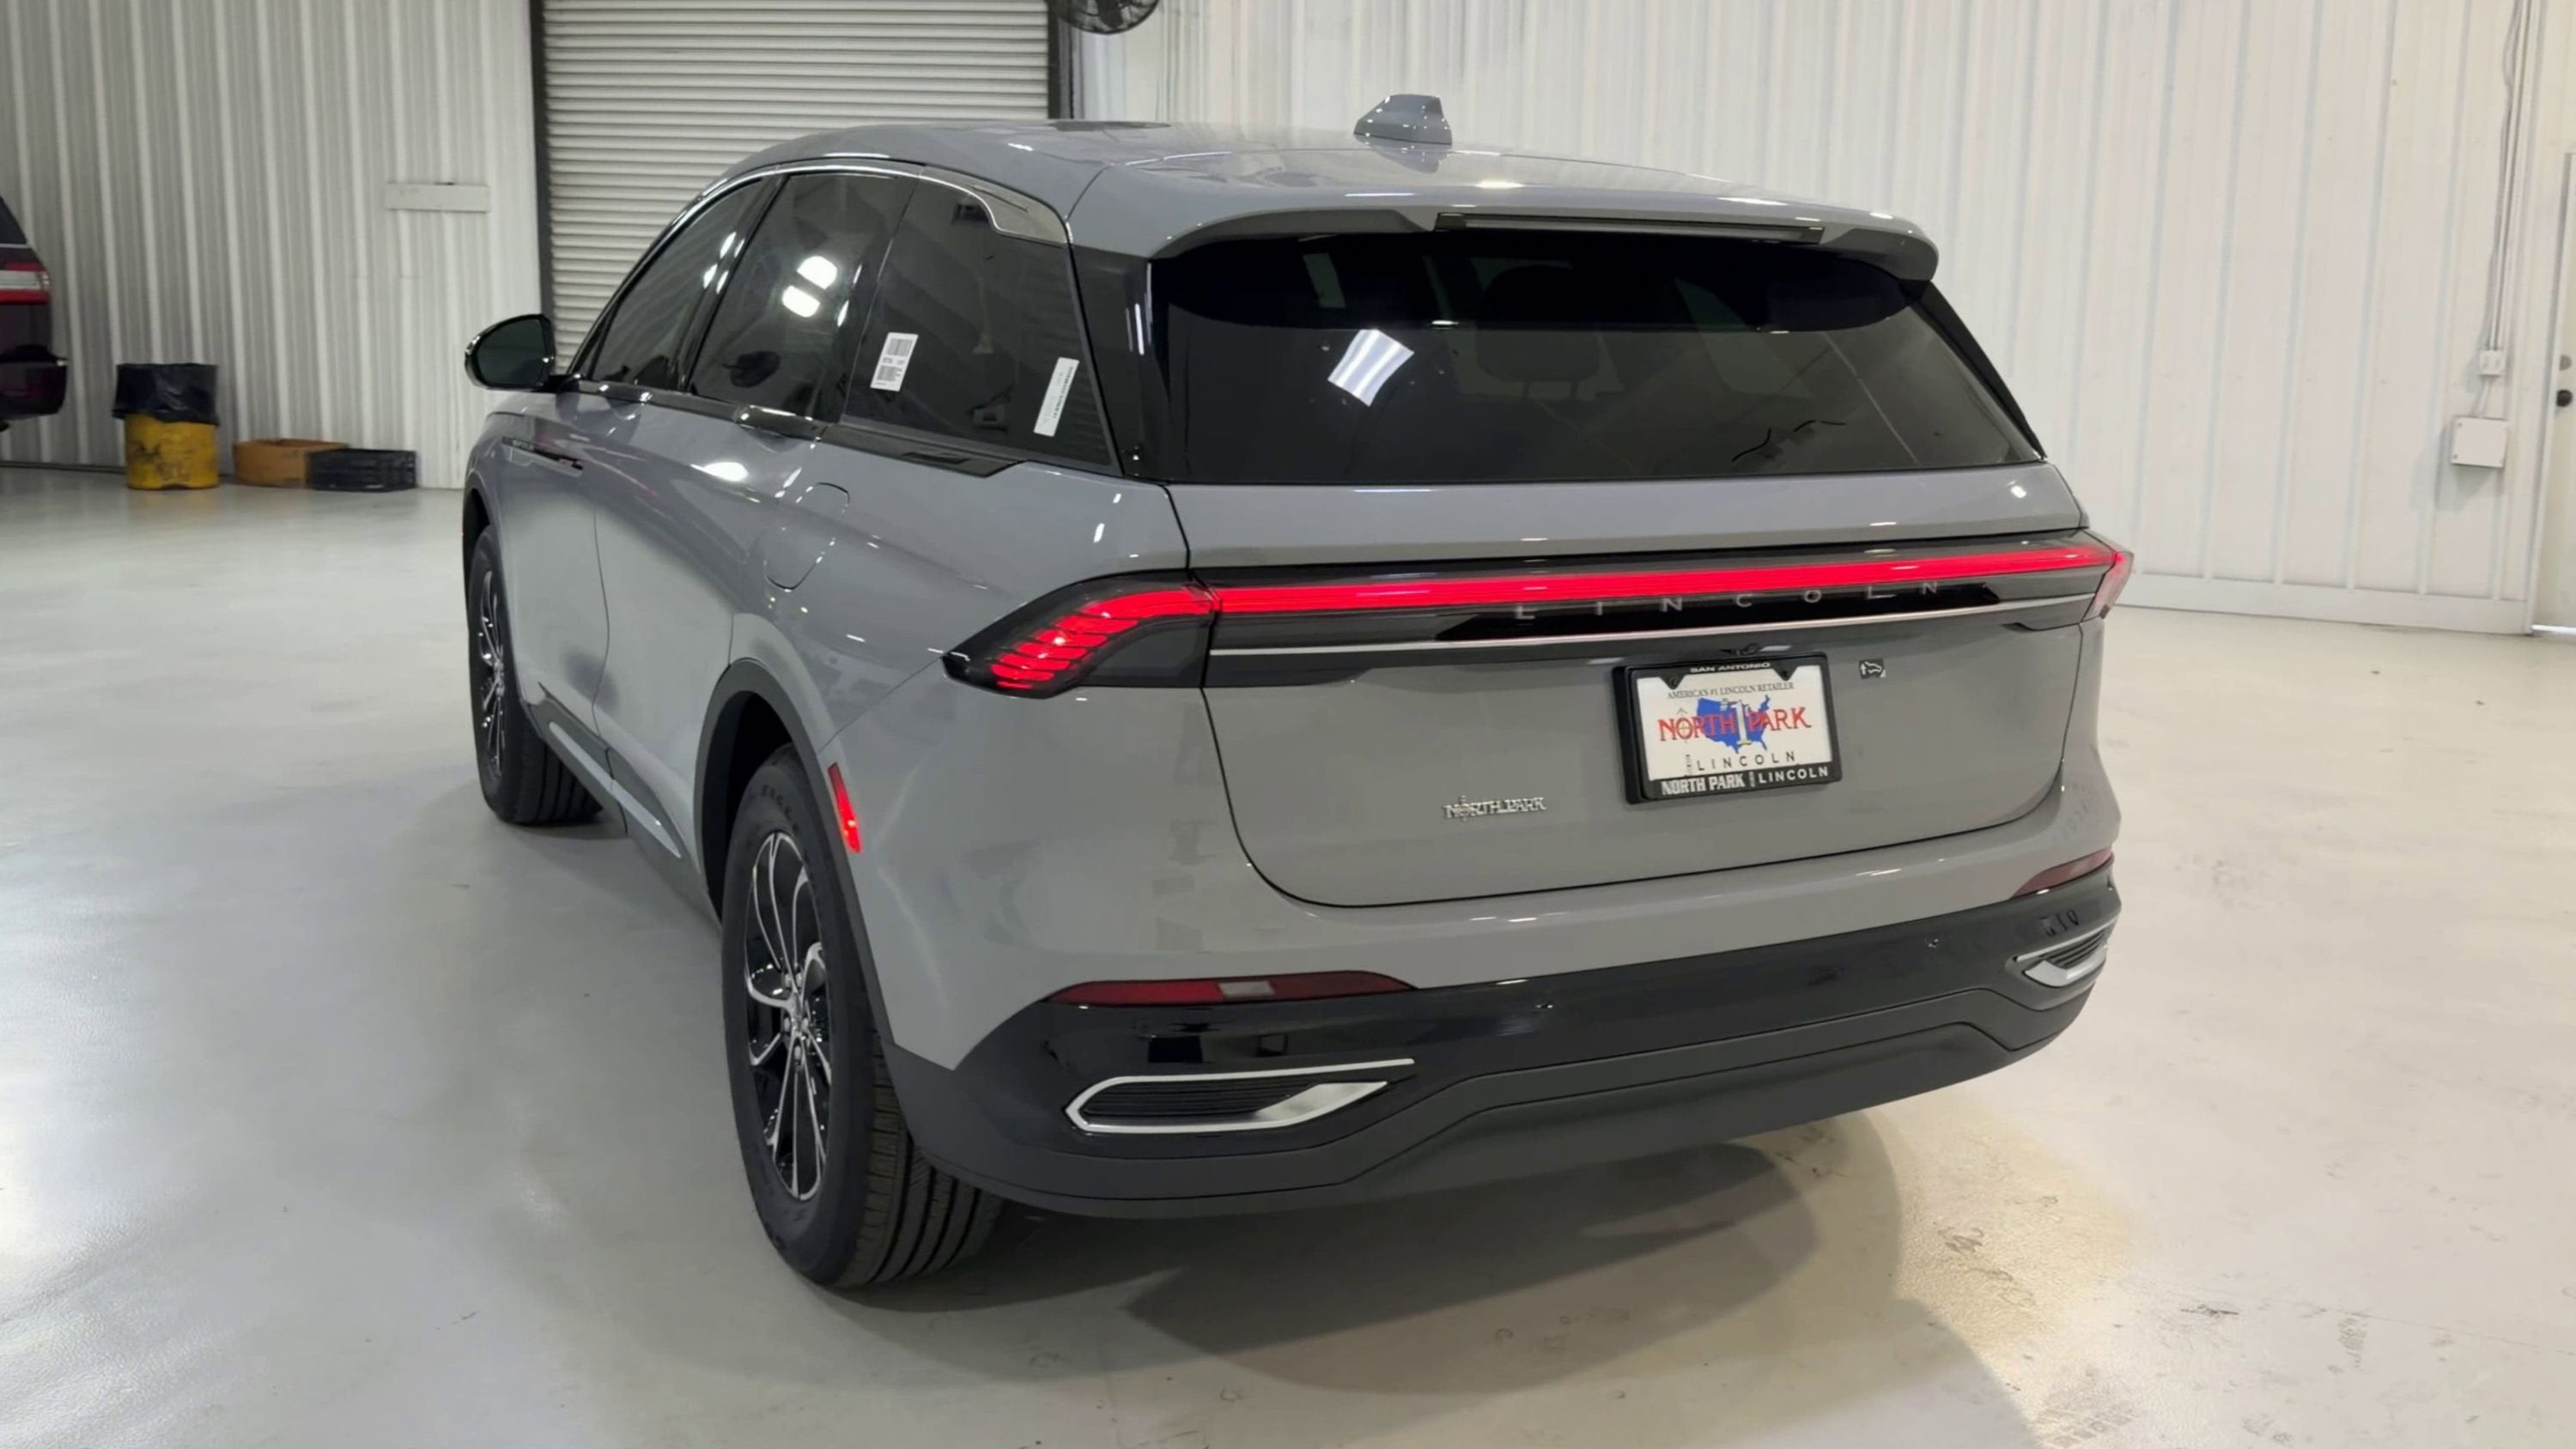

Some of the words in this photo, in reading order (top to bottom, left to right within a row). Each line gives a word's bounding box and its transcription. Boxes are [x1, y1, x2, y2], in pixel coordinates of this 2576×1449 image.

[1516, 581, 1939, 621] LINCOLN
[1718, 662, 1771, 671] ANTONIO
[1720, 684, 1757, 696] LINCOLN
[1758, 681, 1795, 692] RETAILER
[1657, 712, 1737, 742] NORTH
[1747, 706, 1813, 733] PARK
[1697, 750, 1795, 772] LINCOLN
[1661, 776, 1707, 796] NORTH
[1708, 772, 1747, 791] PARK
[1758, 766, 1829, 785] LINCOLN
[1443, 798, 1502, 819] NORTH
[1504, 797, 1547, 814] PARK
